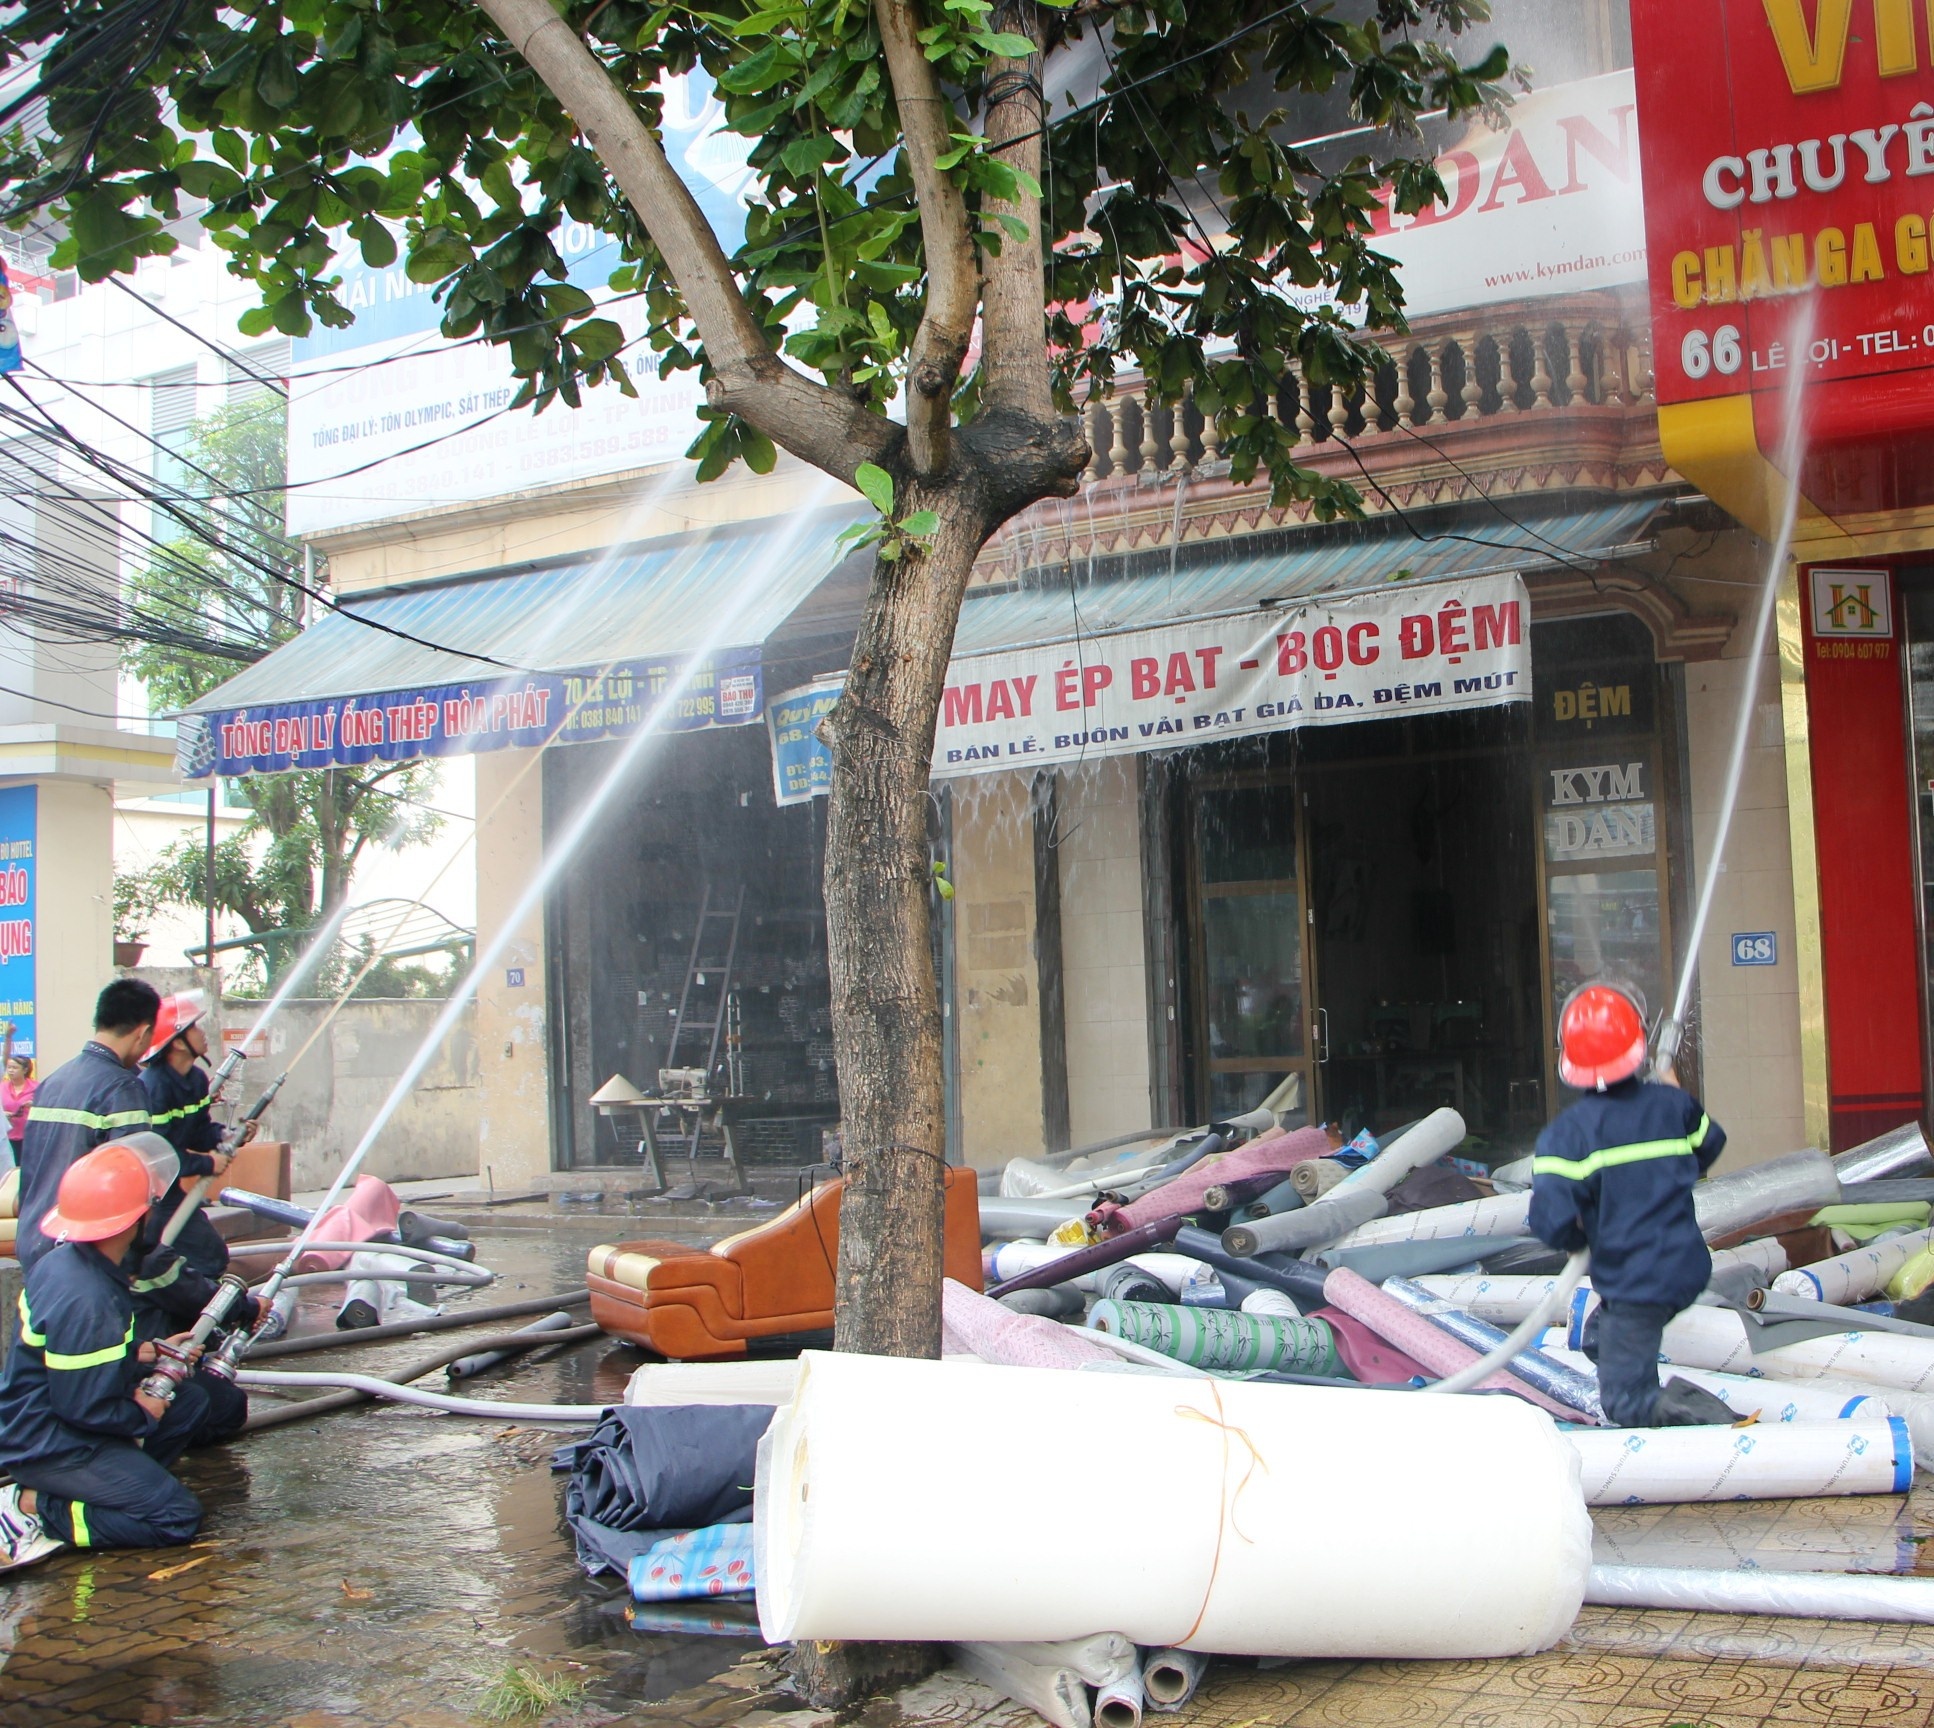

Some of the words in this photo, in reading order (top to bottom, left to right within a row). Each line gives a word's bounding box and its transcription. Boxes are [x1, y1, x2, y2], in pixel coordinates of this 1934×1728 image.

[1761, 0, 1934, 95] VI
[1672, 228, 1808, 309] CHĂN
[1815, 222, 1885, 288] GA
[1895, 210, 1934, 275] G
[1681, 325, 1742, 380] 66
[1752, 342, 1786, 371] LÊ
[1793, 338, 1838, 369] ỢI
[1856, 329, 1918, 356] TEL:
[342, 424, 360, 445] ĐẠI
[405, 402, 456, 429] OLYMPIC,
[482, 385, 511, 411] THÉP
[943, 675, 1038, 728] MAY
[1054, 660, 1113, 712] ÉP
[1131, 646, 1223, 704] BẠT
[1277, 621, 1380, 681] BỌC
[1398, 599, 1521, 665] ĐỆM
[563, 677, 583, 705] 70
[696, 695, 715, 716] 995
[1554, 681, 1631, 729] ĐỆM
[222, 709, 272, 760] TỔNG
[275, 716, 308, 760] ĐẠI
[312, 706, 336, 751] LÝ
[341, 699, 384, 748] ỐNG
[387, 696, 439, 743] THÉP
[444, 689, 489, 738] HÒA
[492, 683, 550, 732] PHÁT
[947, 744, 999, 763] BÁN
[1054, 726, 1129, 749] BUÔN
[1138, 716, 1184, 735] VẢI
[1193, 708, 1247, 729] BẠT
[1256, 694, 1303, 719] GIẢ
[1373, 682, 1442, 704] ĐỆM
[1454, 671, 1519, 694] MÚT
[1550, 762, 1644, 805] KYM
[1555, 811, 1643, 852] DAN
[1737, 938, 1771, 960] 68
[510, 971, 521, 984] 70
